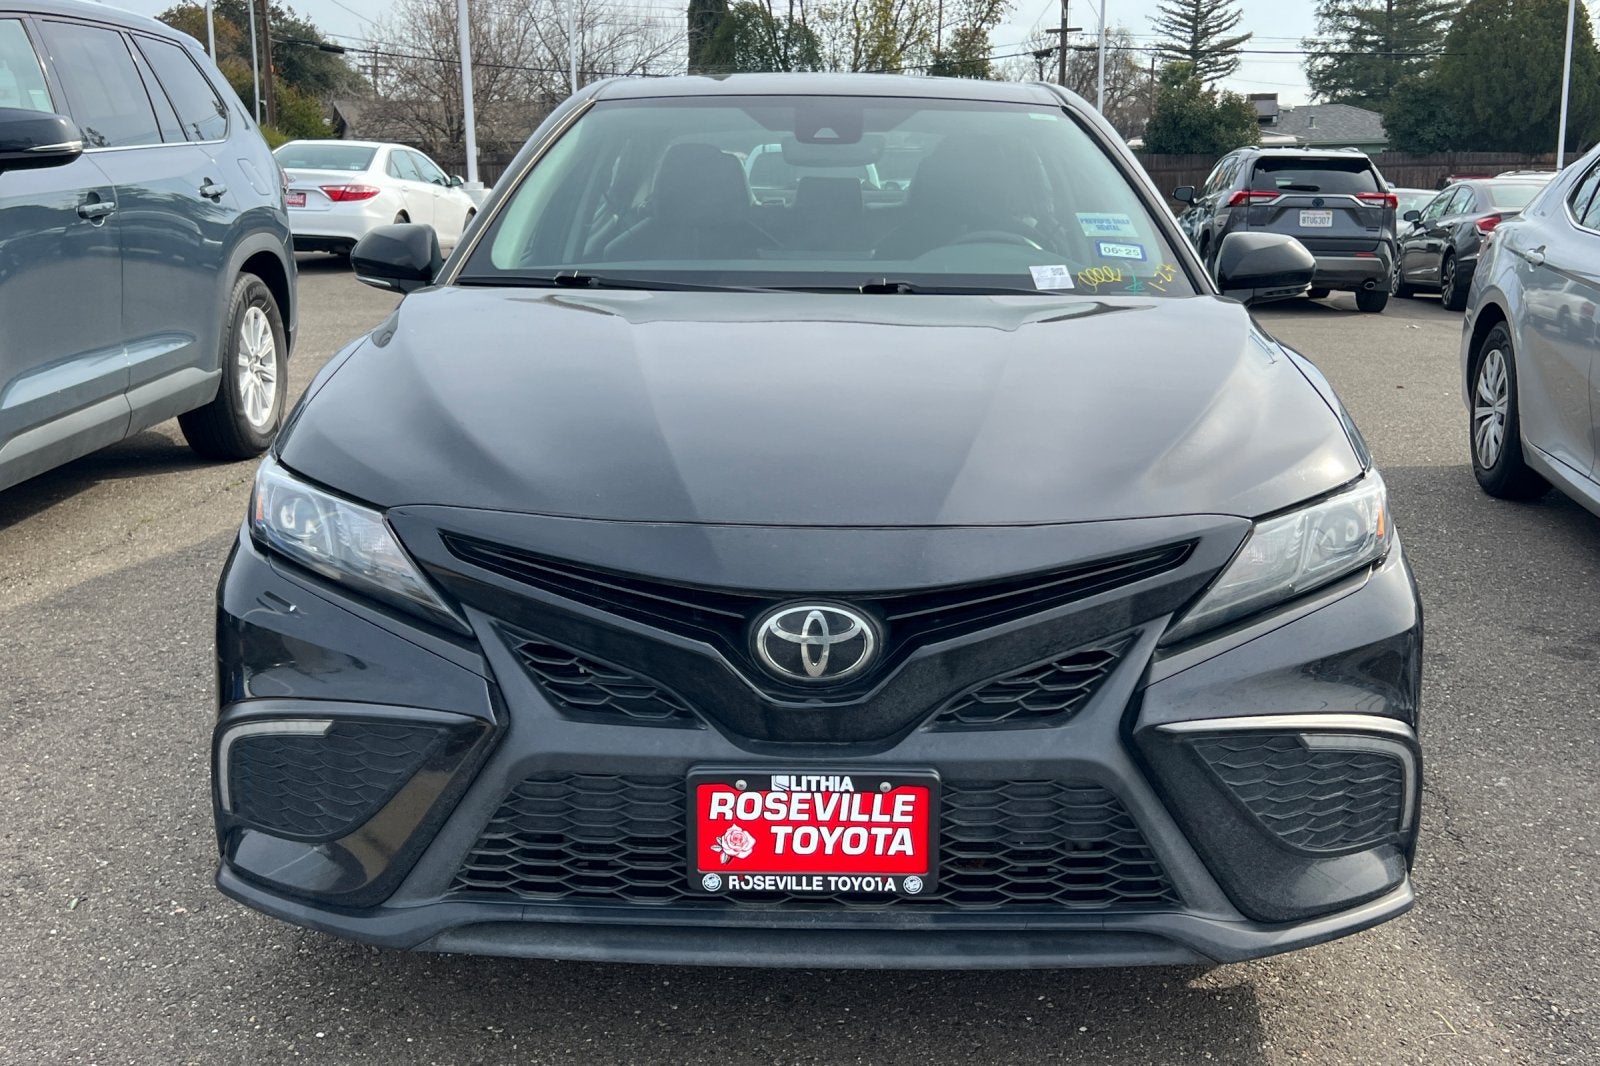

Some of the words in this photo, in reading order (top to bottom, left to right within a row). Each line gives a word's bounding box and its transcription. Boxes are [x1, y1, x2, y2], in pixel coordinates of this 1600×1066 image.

[790, 775, 855, 792] LITHIA
[709, 791, 916, 823] ROSEVILLE
[770, 825, 914, 856] TOYOTA
[728, 875, 823, 891] ROSEVILLE
[827, 876, 897, 892] TOYOTA
